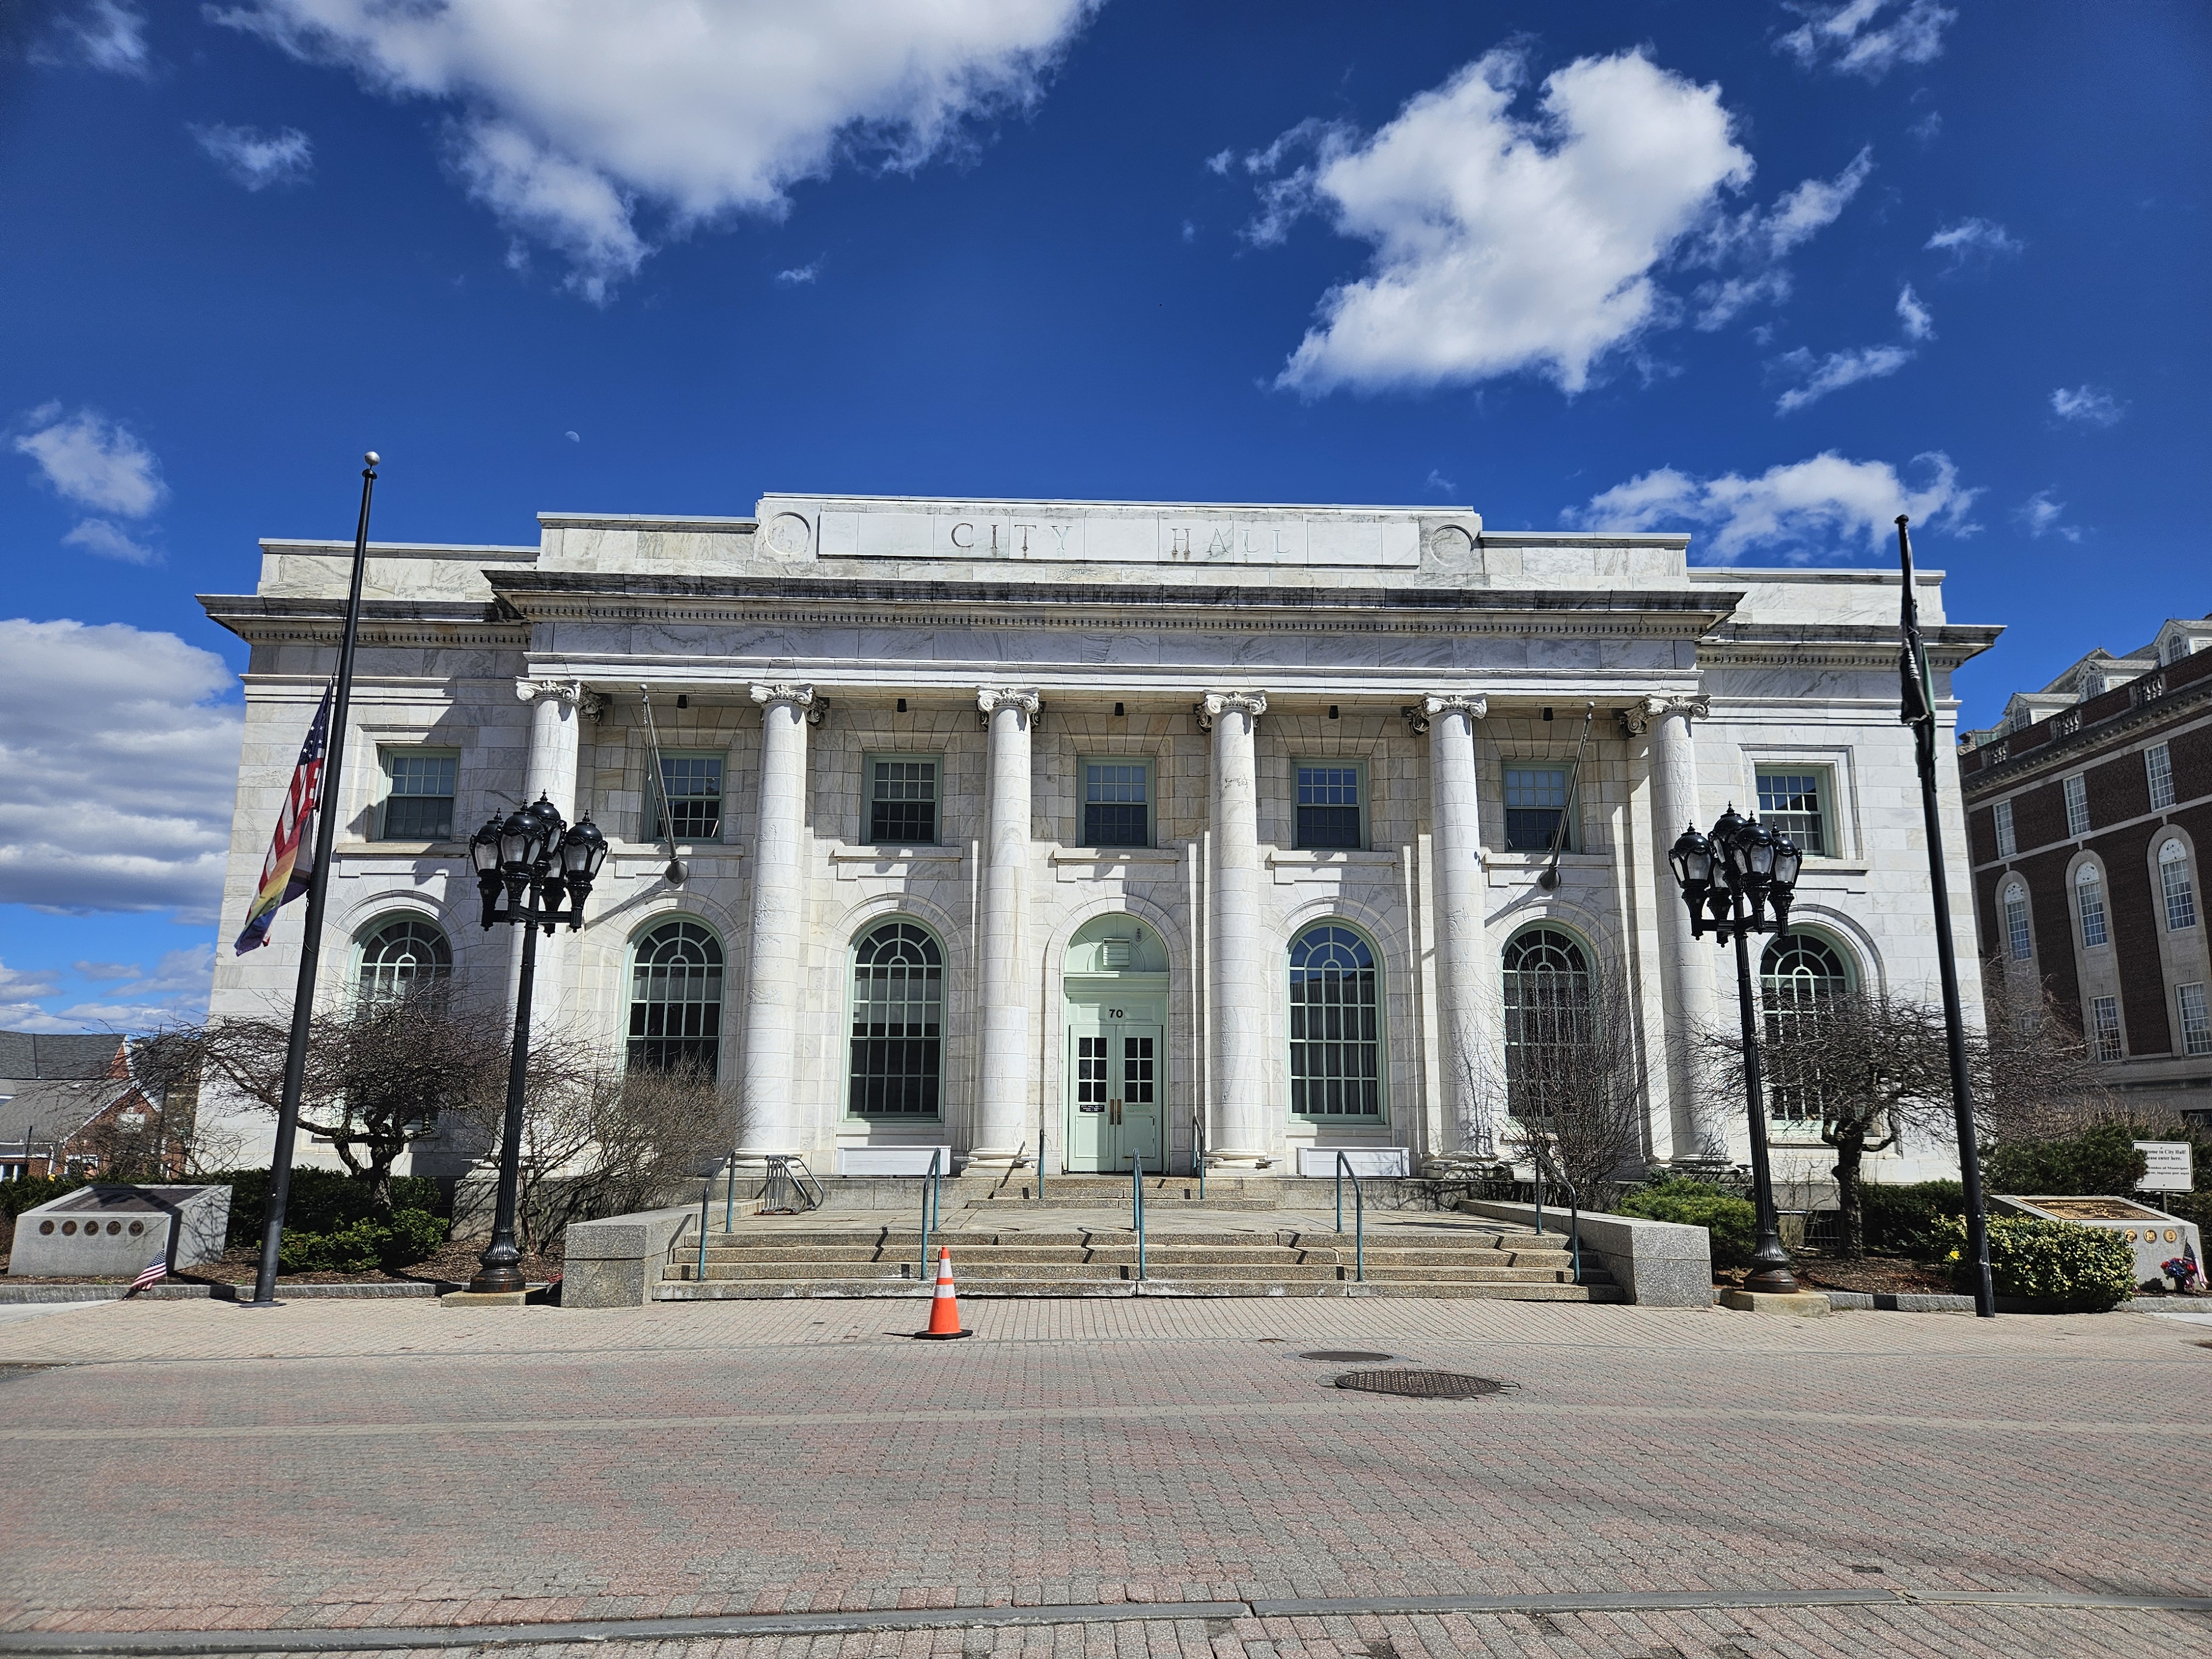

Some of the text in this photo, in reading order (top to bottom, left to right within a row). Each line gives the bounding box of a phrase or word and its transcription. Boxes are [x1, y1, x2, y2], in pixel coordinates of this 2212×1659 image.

[951, 522, 1291, 554] CITY HALL
[1109, 1009, 1124, 1019] 70
